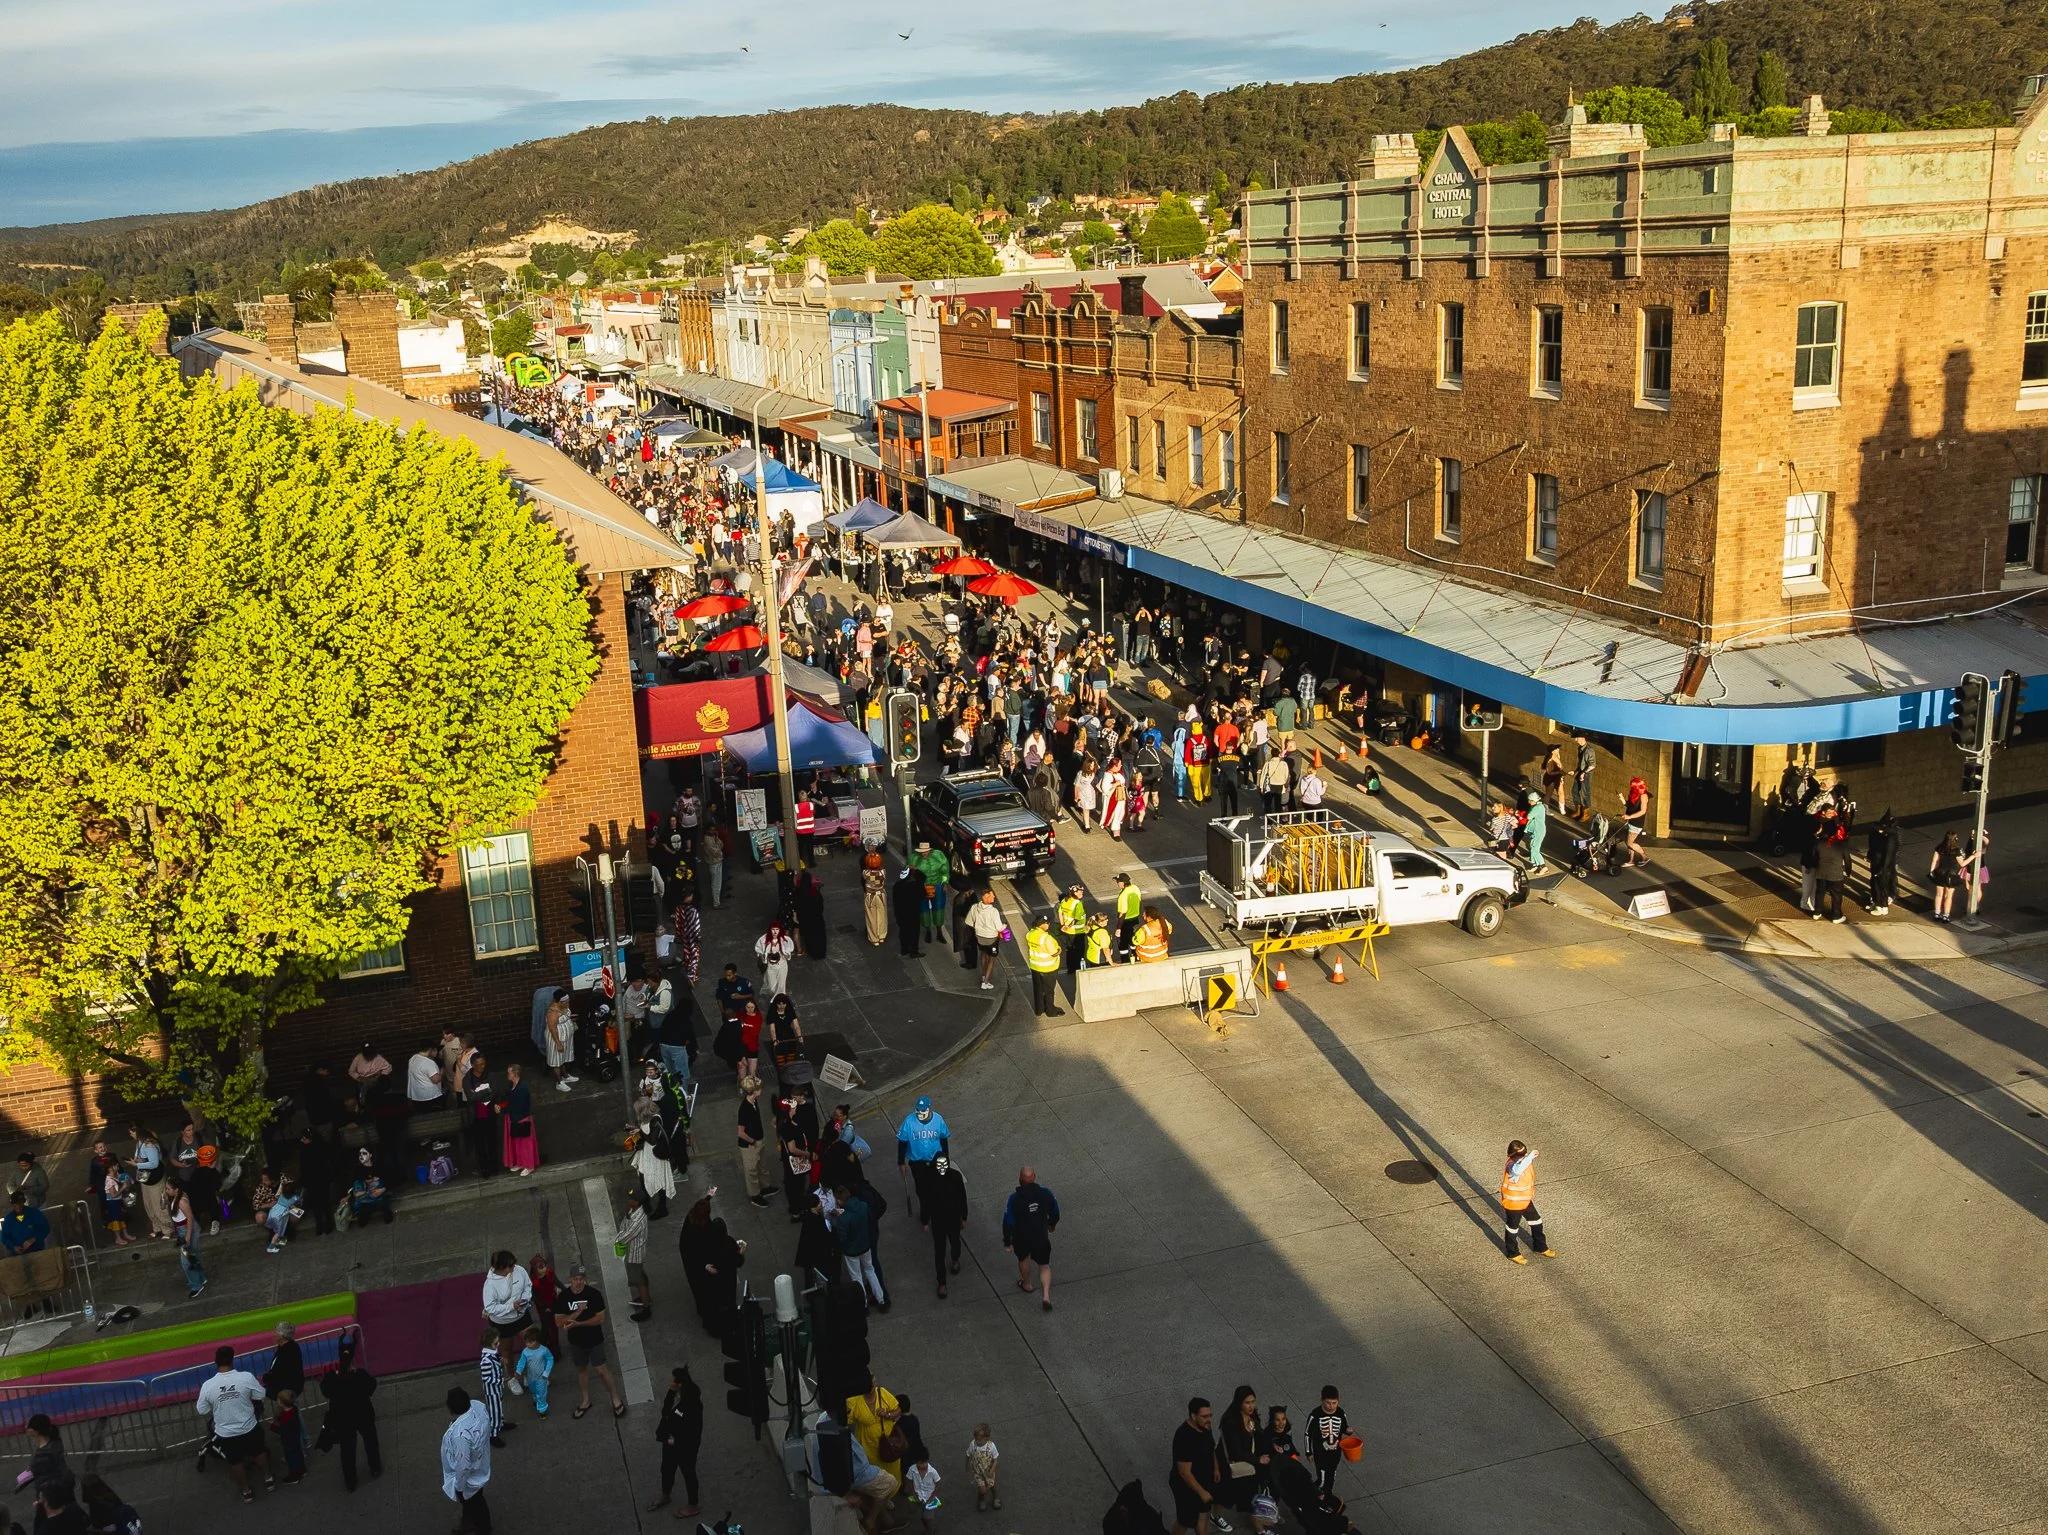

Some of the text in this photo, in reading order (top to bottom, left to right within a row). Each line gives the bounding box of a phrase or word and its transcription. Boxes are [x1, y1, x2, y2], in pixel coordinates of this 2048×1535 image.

[1434, 172, 1466, 185] GRAND
[1429, 188, 1471, 202] CENTRAL
[1434, 206, 1464, 219] HOTEL
[418, 391, 479, 405] IGGINS
[1084, 536, 1112, 553] OPTOMETRIST
[660, 742, 701, 753] Academy
[1314, 935, 1335, 943] CLOSED
[912, 1130, 938, 1140] LIONS
